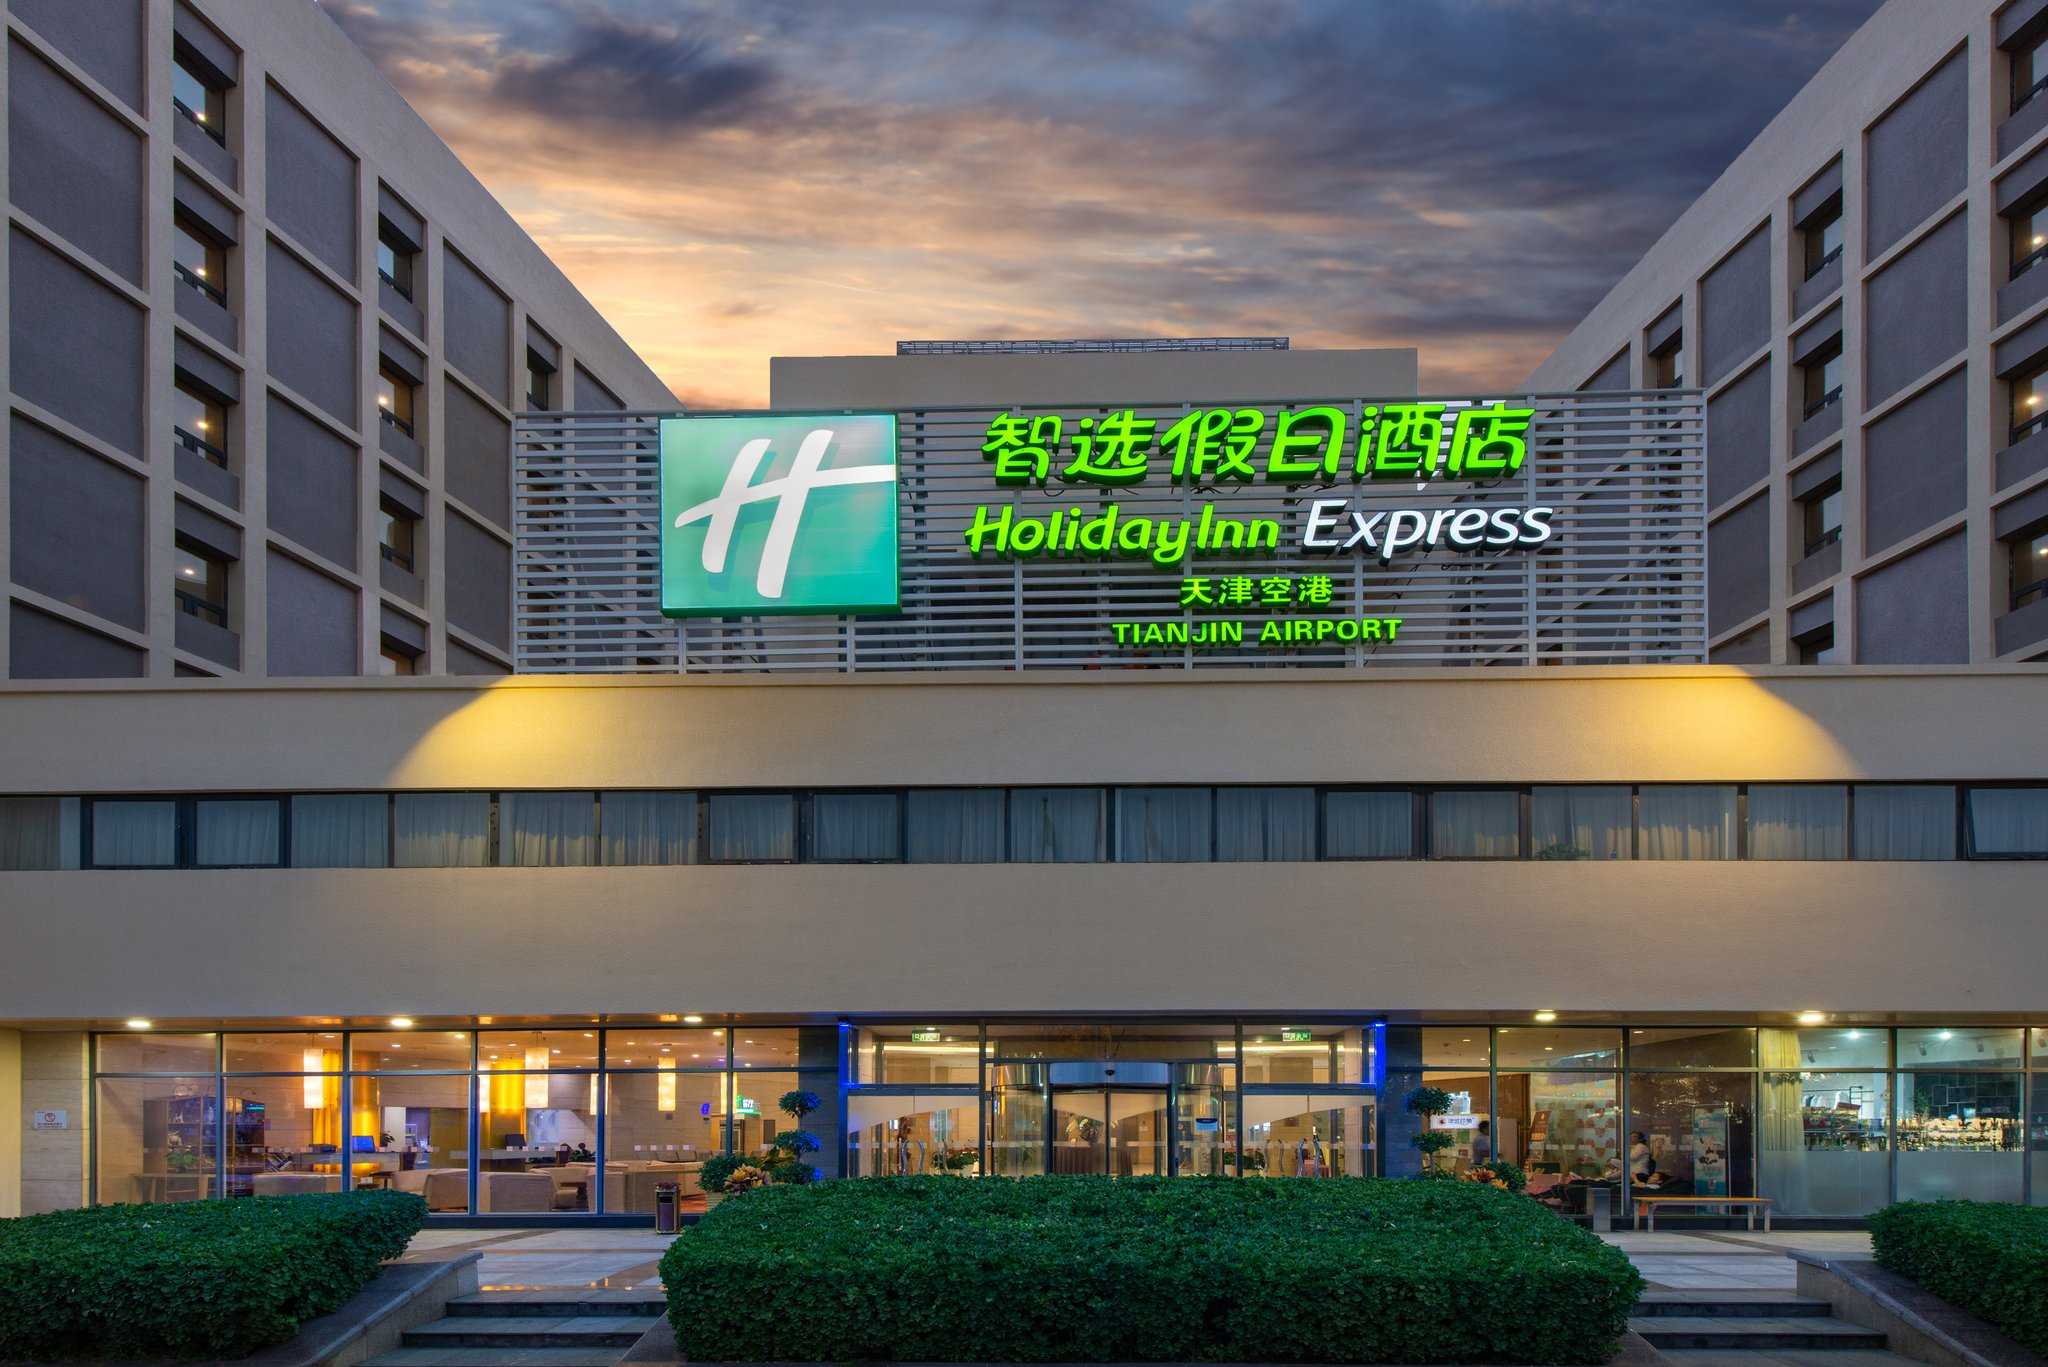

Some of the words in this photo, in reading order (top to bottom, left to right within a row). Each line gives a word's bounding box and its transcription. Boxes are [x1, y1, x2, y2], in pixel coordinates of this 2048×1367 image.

[981, 402, 1536, 480] 智选假日酒店
[1302, 499, 1553, 560] Express
[1180, 574, 1334, 606] 天津空港
[1112, 621, 1243, 644] TIANJIN
[1260, 618, 1403, 642] AIRPORT
